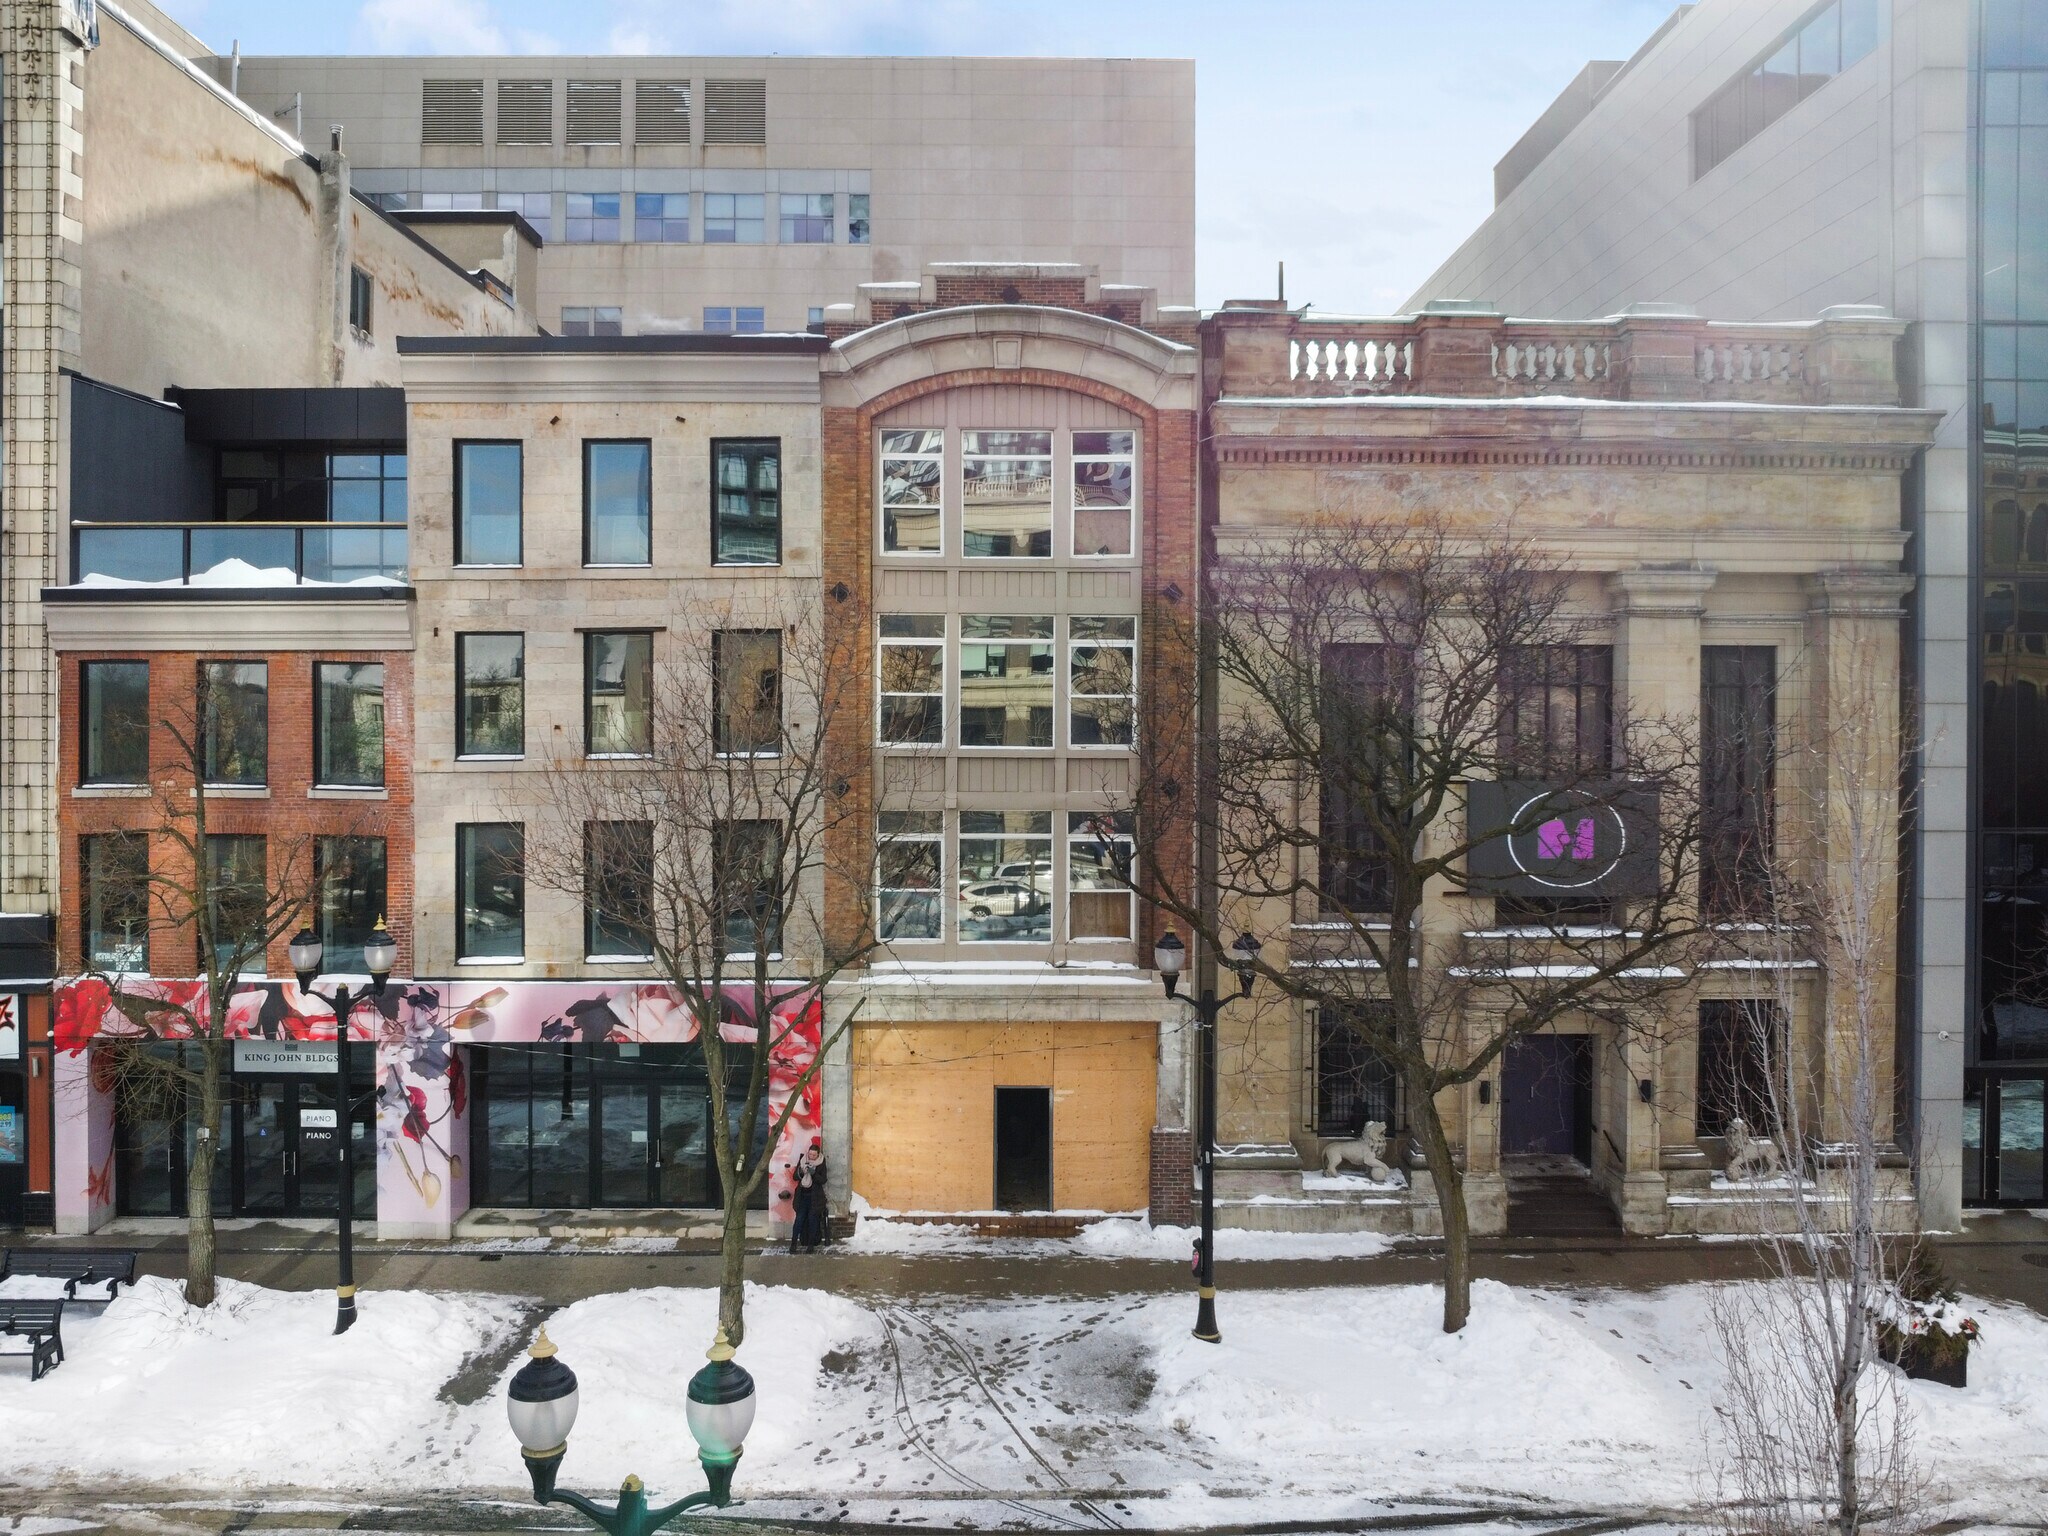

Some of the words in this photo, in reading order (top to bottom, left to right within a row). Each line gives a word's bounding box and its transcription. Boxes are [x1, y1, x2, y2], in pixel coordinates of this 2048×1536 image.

[244, 1053, 271, 1062] KING
[273, 1053, 302, 1064] JOHN
[305, 1054, 339, 1063] BLDGS
[306, 1132, 332, 1140] PIANO
